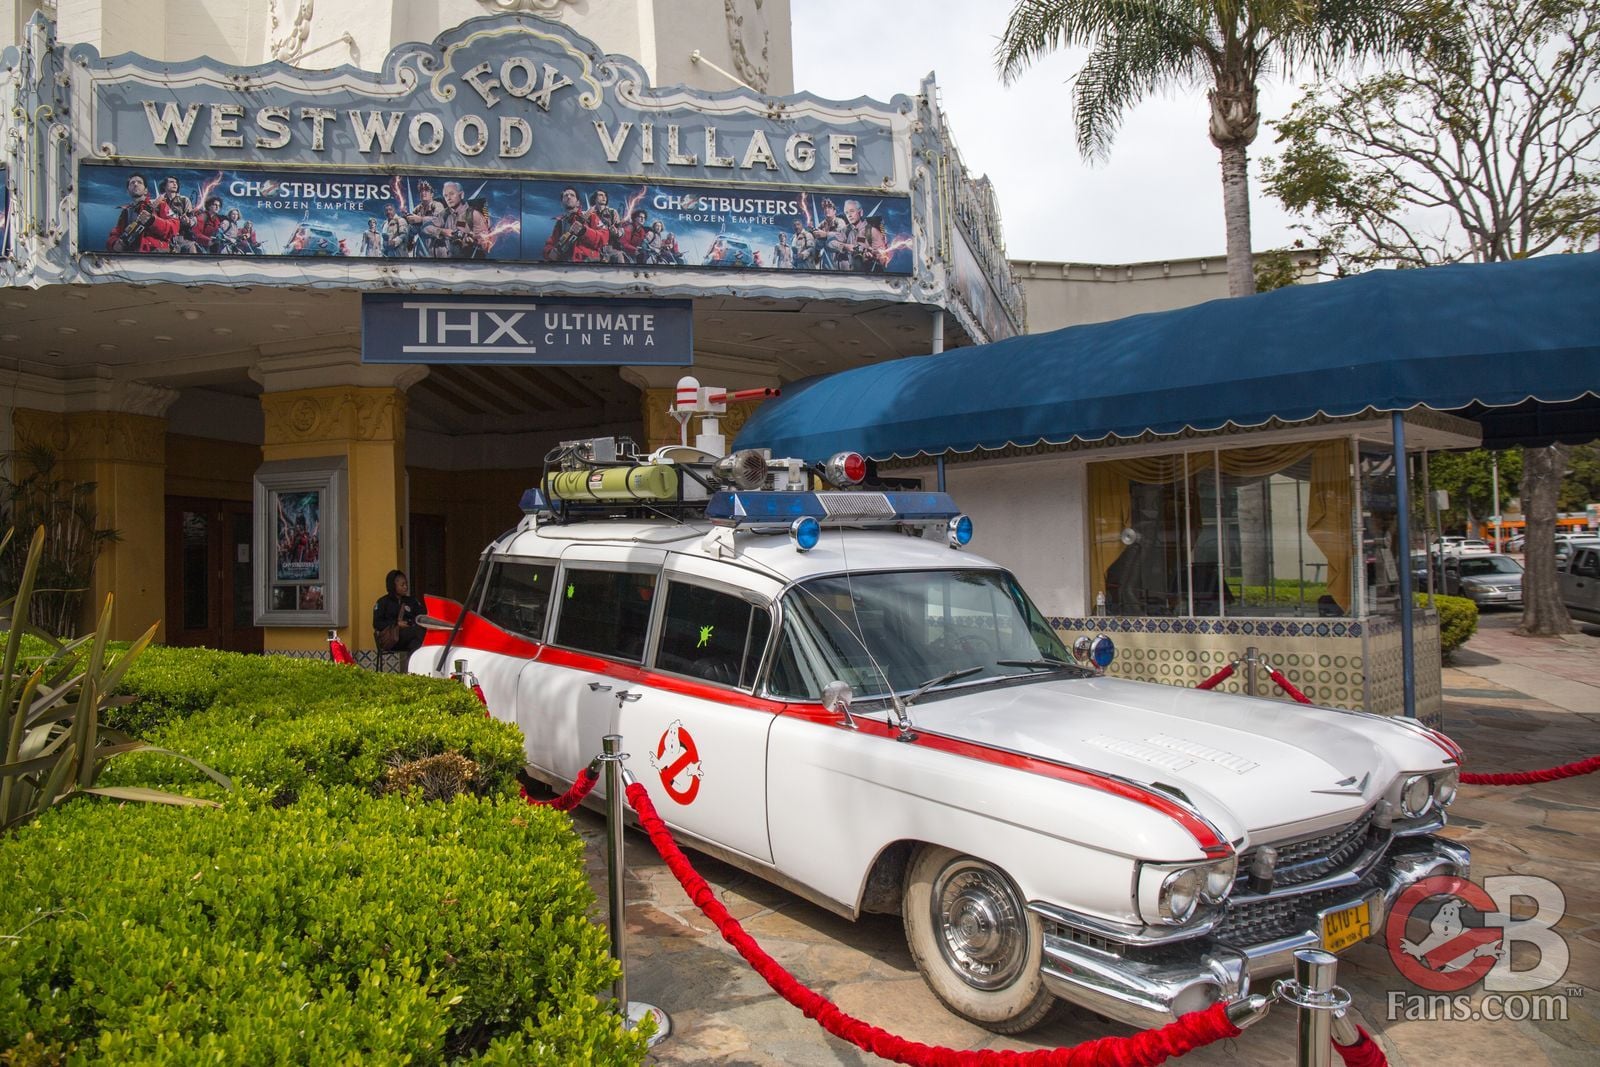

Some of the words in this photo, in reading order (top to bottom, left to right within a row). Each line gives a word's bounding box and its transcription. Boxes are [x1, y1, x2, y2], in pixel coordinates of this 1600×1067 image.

[460, 56, 574, 112] FOX
[141, 100, 533, 158] WESTWOOD
[592, 120, 859, 175] VILLAGE
[257, 200, 309, 210] FROZEN
[316, 201, 365, 211] EMPIRE
[678, 213, 726, 223] FROZEN
[731, 215, 775, 225] EMPIRE
[403, 302, 536, 345] THX
[544, 312, 655, 331] ULTIMATE
[544, 333, 655, 346] CINEMA
